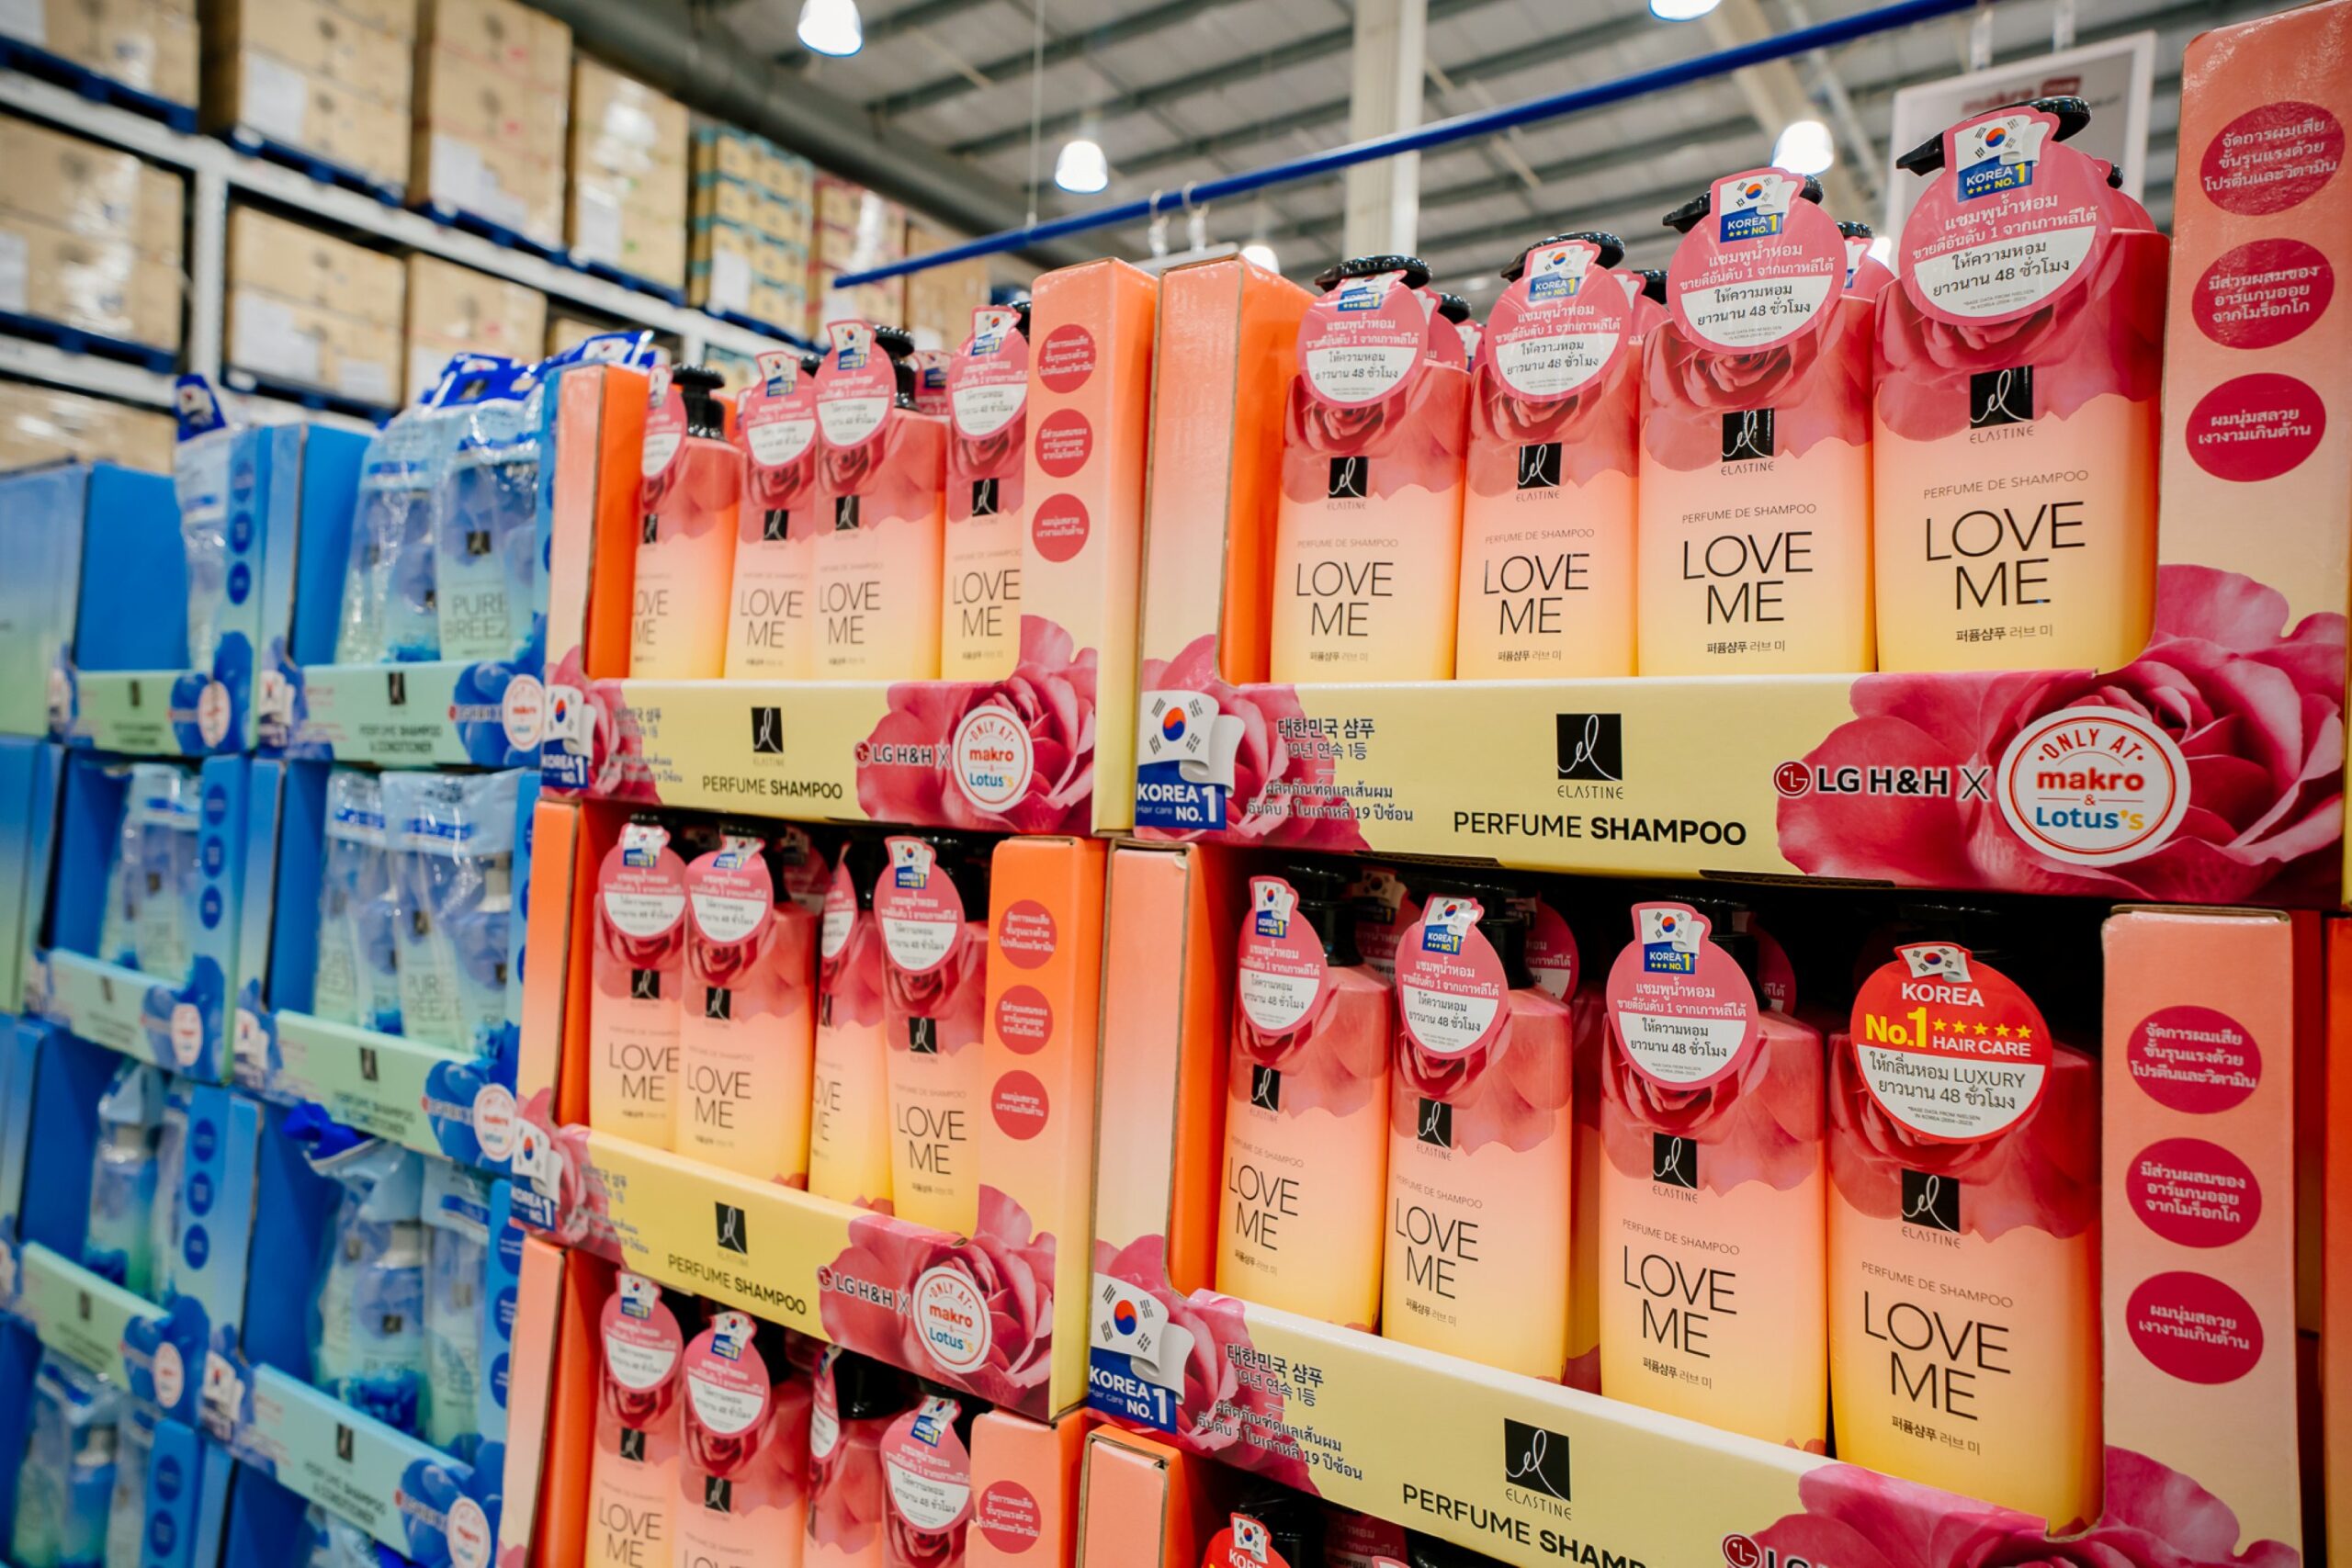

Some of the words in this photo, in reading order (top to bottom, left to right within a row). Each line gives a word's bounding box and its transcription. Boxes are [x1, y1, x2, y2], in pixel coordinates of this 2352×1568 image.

[1966, 165, 2013, 186] KOREA
[1994, 177, 2015, 189] NO.
[2015, 162, 2027, 184] 1
[1727, 216, 1768, 231] KOREA
[1751, 225, 1770, 236] NO.
[1769, 214, 1779, 233] 1
[1944, 193, 2059, 231] แชมพูน้ำหอม
[1990, 226, 1999, 239] 1
[2002, 206, 2098, 236] จากเกาหลีใต้
[1951, 240, 2048, 271] ให้ความหอม
[1932, 273, 1991, 298] ยาวนาน
[1994, 267, 2016, 282] 48
[2018, 256, 2071, 278] ชั่วโมง
[2208, 265, 2319, 291] มีส่วนผสมของ
[2211, 408, 2300, 429] ผมนุ่มสลวย
[1969, 425, 2036, 445] ELASTINE
[1720, 461, 1775, 477] ELASTINE
[1923, 481, 1984, 501] PERFUME
[1987, 478, 2008, 492] DE
[2010, 468, 2090, 490] SHAMPOO
[1681, 509, 1733, 525] PERFUME
[1735, 507, 1752, 520] DE
[1753, 502, 1817, 518] SHAMPOO
[1925, 501, 2086, 562] LOVE
[1682, 530, 1815, 581] LOVE
[953, 569, 1022, 604] LOVE
[1295, 561, 1395, 597] LOVE
[1484, 553, 1590, 595] LOVE
[1955, 558, 2052, 611] ME
[819, 581, 881, 613] LOVE
[1706, 580, 1785, 626] ME
[827, 615, 865, 645] ME
[962, 606, 1004, 638] ME
[1311, 602, 1370, 637] ME
[1499, 596, 1564, 636] ME
[1706, 640, 1748, 655] 퍼퓸샴푸
[1955, 625, 2007, 643] 퍼퓸샴푸
[2008, 625, 2035, 640] 러브
[2039, 624, 2053, 638] 미
[1277, 717, 1339, 739] 대한민국
[1342, 718, 1375, 739] 샴푸
[2041, 728, 2100, 760] ONLY
[2109, 734, 2143, 760] AT
[874, 746, 893, 762] LG
[897, 747, 933, 764] H&H
[937, 746, 951, 767] X
[969, 749, 1014, 762] makro
[1317, 741, 1344, 760] 연속
[1348, 742, 1368, 761] 1등
[702, 775, 767, 795] PERFUME
[770, 780, 843, 800] SHAMPOO
[1136, 784, 1200, 804] KOREA
[1556, 784, 1625, 801] ELASTINE
[1817, 768, 1860, 794] LG
[1869, 767, 1949, 795] H&H
[1961, 768, 1990, 801] X
[2036, 768, 2145, 793] makro
[1155, 806, 1173, 815] care
[1175, 806, 1203, 822] NO.
[1201, 785, 1218, 824] 1
[1286, 802, 1294, 816] 1
[1354, 806, 1371, 820] 19
[1374, 802, 1414, 823] ปีซ้อน
[2084, 794, 2097, 807] &
[1453, 811, 1582, 840] PERFUME
[1589, 817, 1747, 847] SHAMPOO
[2036, 807, 2145, 830] Lotus's
[1648, 950, 1682, 963] KOREA
[1668, 962, 1684, 971] NO.
[1681, 952, 1692, 972] 1
[1634, 976, 1716, 1000] แชมพูน้ำหอม
[1901, 982, 1984, 1007] KOREA
[1641, 1017, 1709, 1038] ให้ความหอม
[1865, 1007, 1928, 1048] No.1
[2145, 1021, 2243, 1045] จัดการผมเสีย
[1630, 1037, 1669, 1054] ยาวนาน
[1671, 1041, 1688, 1055] 48
[1688, 1037, 1727, 1058] ชั่วโมง
[1932, 1035, 1976, 1054] HAIR
[1978, 1040, 2031, 1057] CARE
[686, 1065, 752, 1100] LOVE
[1869, 1051, 1950, 1083] ให้กลิ่นหอม
[1953, 1067, 2026, 1089] LUXURY
[1878, 1078, 1937, 1101] ยาวนาน
[1939, 1087, 1961, 1103] 48
[1963, 1083, 2017, 1111] ชั่วโมง
[695, 1096, 735, 1130] ME
[897, 1101, 967, 1141] LOVE
[909, 1139, 953, 1176] ME
[1228, 1156, 1300, 1217] LOVE
[2140, 1160, 2246, 1190] มีส่วนผสมของ
[1652, 1184, 1699, 1204] ELASTINE
[1236, 1201, 1279, 1251] ME
[1396, 1197, 1479, 1262] LOVE
[1622, 1218, 1662, 1241] PERFUME
[1664, 1229, 1679, 1244] DE
[1680, 1233, 1740, 1256] SHAMPOO
[1901, 1225, 1962, 1249] ELASTINE
[668, 1253, 732, 1289] PERFUME
[734, 1276, 808, 1315] SHAMPOO
[1406, 1246, 1456, 1301] ME
[1623, 1244, 1738, 1315] LOVE
[1860, 1260, 1915, 1287] PERFUME
[1917, 1276, 1936, 1292] DE
[1939, 1280, 2014, 1309] SHAMPOO
[835, 1277, 854, 1294] LG
[858, 1284, 894, 1307] H&H
[929, 1303, 973, 1329] makro
[1642, 1298, 1711, 1359] ME
[2149, 1303, 2237, 1330] ผมนุ่มสลวย
[1863, 1290, 2011, 1375] LOVE
[1226, 1343, 1288, 1379] 대한민국
[1292, 1362, 1325, 1389] 샴푸
[1089, 1364, 1150, 1402] KOREA
[1891, 1350, 1979, 1421] ME
[1126, 1398, 1154, 1421] NO.
[1152, 1388, 1168, 1425] 1
[1891, 1415, 1938, 1442] 퍼퓸샴푸
[598, 1495, 663, 1542] LOVE
[1402, 1483, 1532, 1546] PERFUME
[1505, 1487, 1573, 1521] ELASTINE
